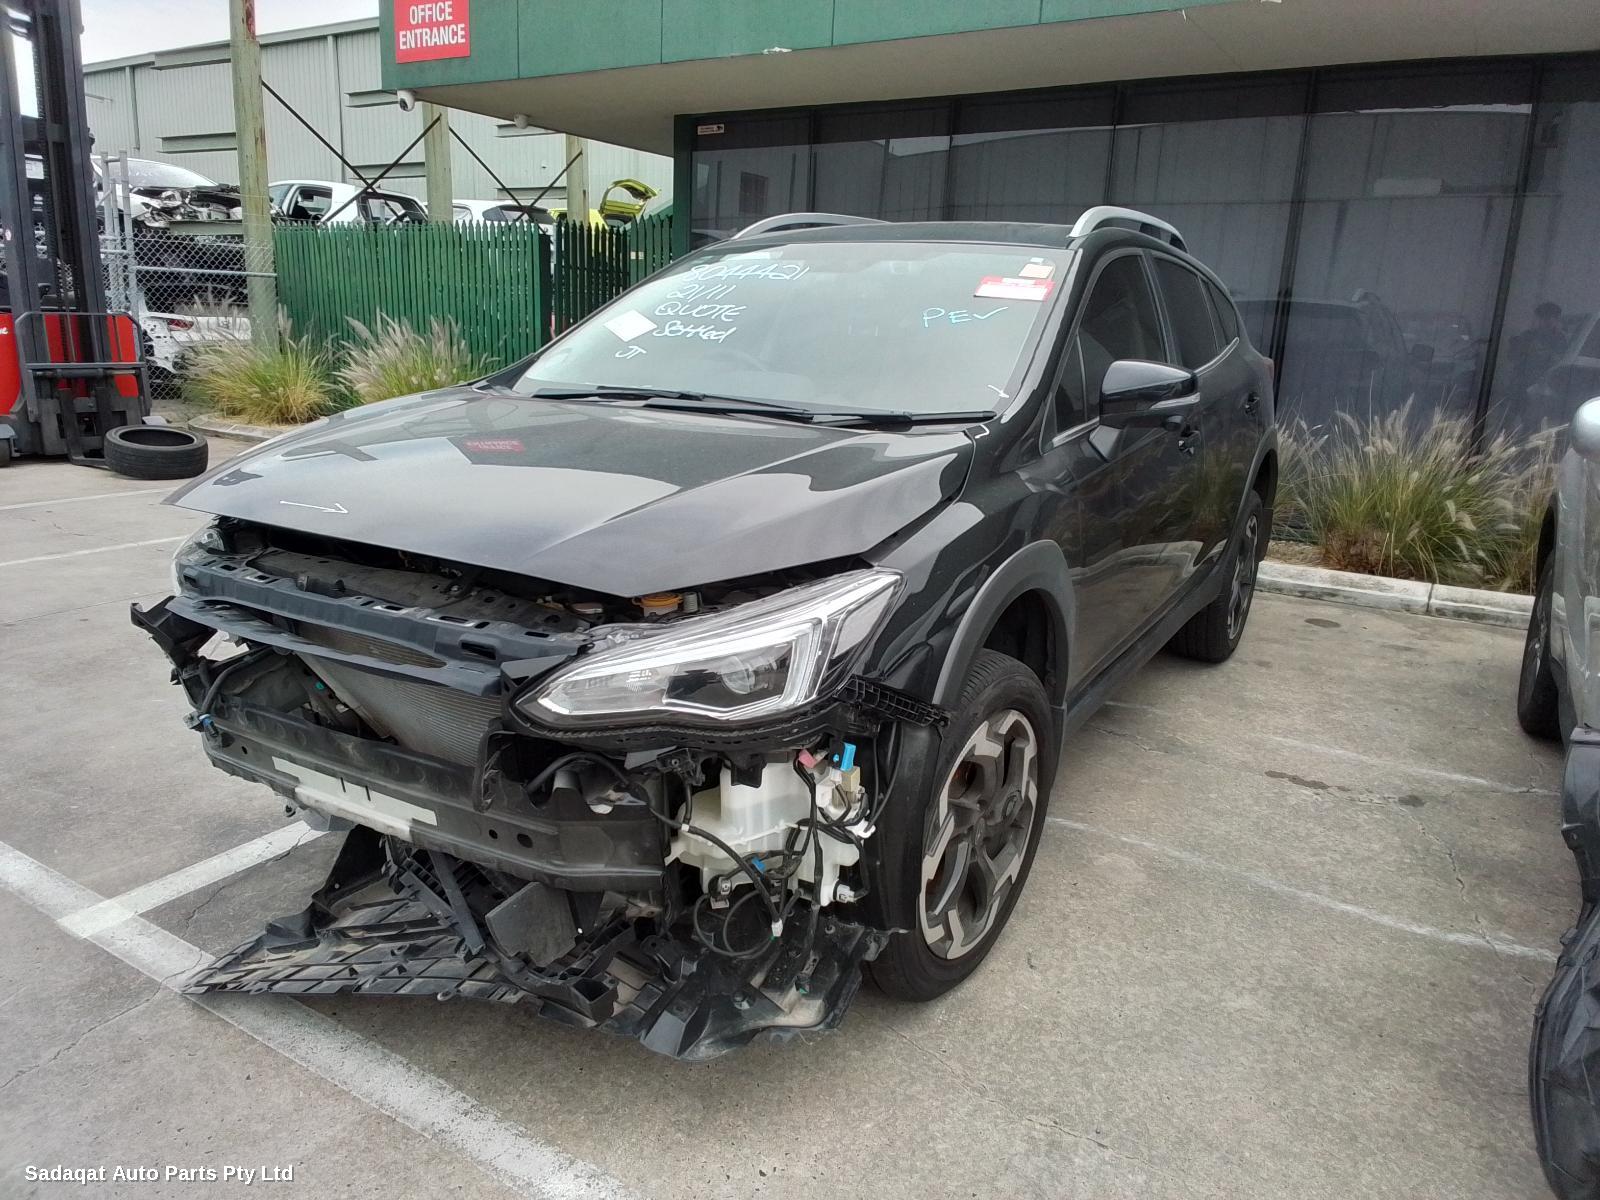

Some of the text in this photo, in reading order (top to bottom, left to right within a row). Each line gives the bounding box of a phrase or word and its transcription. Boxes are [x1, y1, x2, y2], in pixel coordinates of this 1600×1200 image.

[409, 1, 454, 25] OFFICE
[399, 23, 466, 50] ENTRANCE
[654, 301, 747, 322] QUOTE
